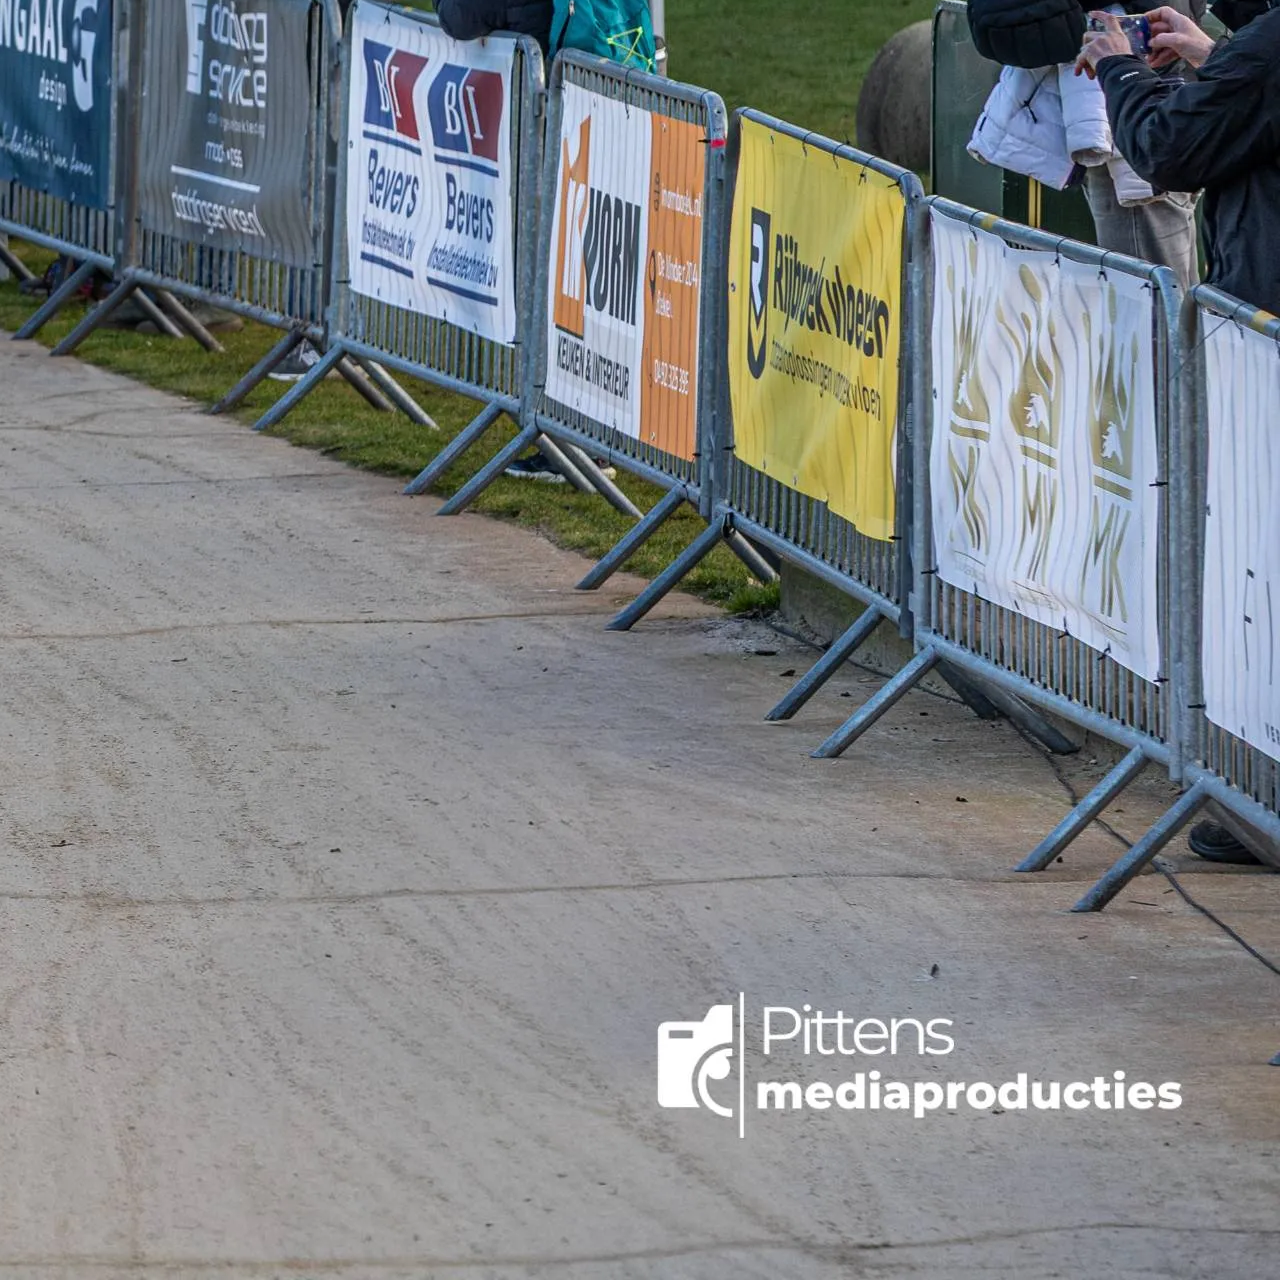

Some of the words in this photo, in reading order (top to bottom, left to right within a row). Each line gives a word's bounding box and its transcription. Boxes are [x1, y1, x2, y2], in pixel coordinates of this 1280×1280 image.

[39, 70, 67, 111] design
[368, 148, 420, 218] Bevers
[445, 172, 494, 243] Bevers
[556, 335, 584, 378] KEUKEN
[592, 357, 630, 400] INTERIEUR
